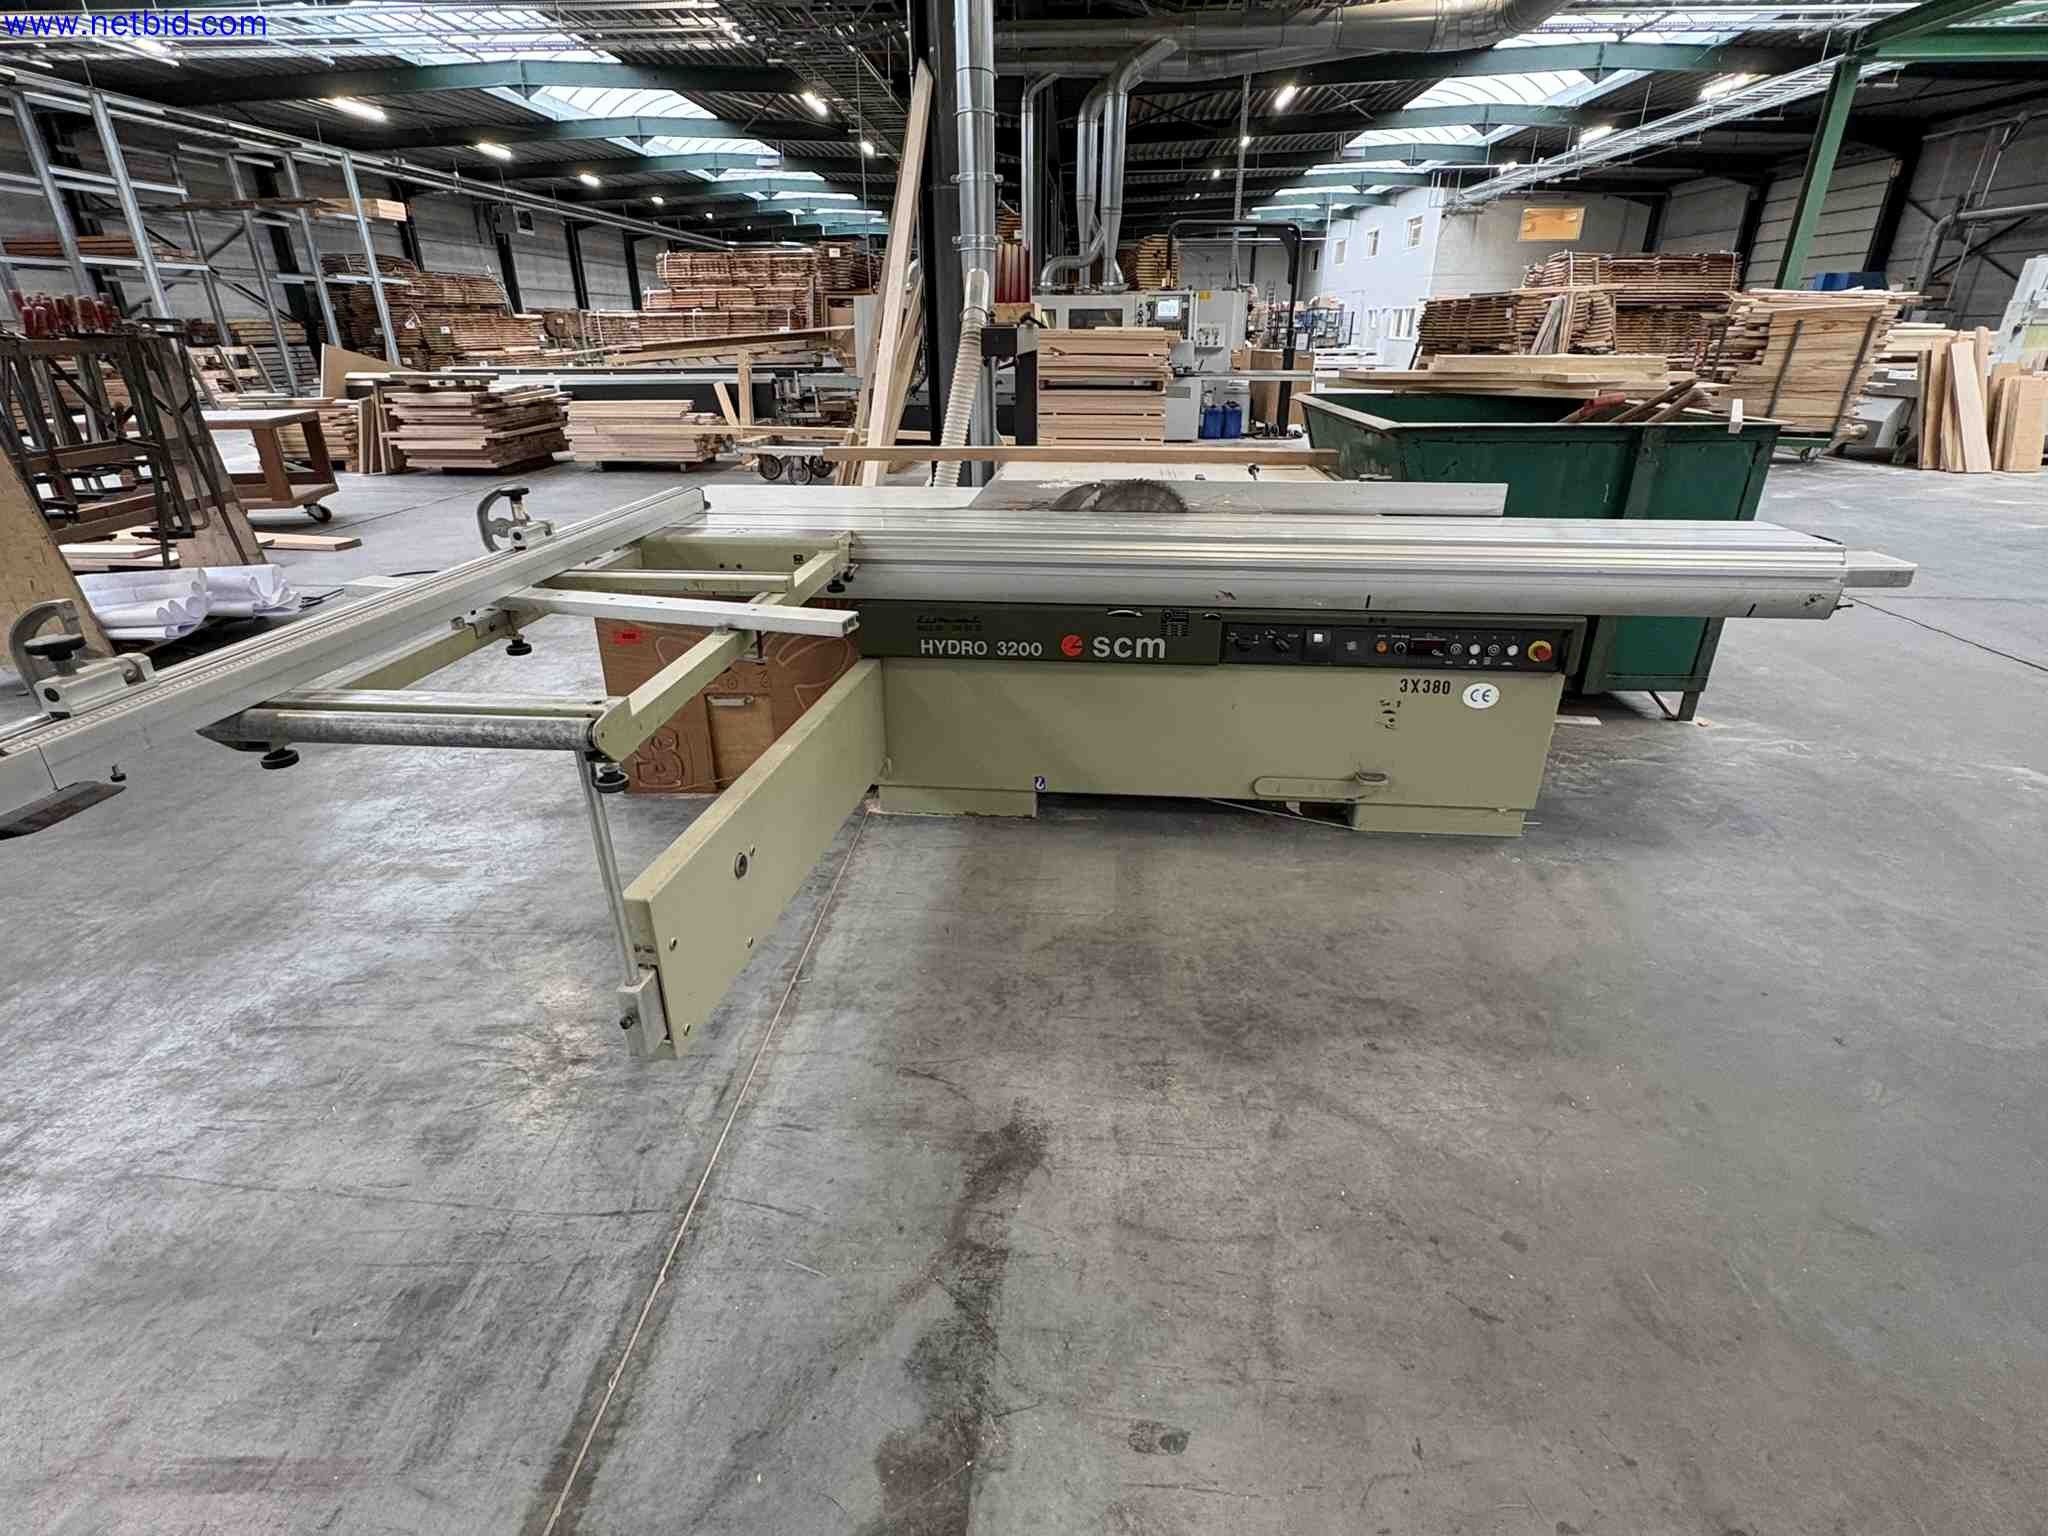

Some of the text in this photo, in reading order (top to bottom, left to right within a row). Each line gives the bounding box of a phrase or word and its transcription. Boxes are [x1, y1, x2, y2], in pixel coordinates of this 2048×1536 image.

[920, 639, 1043, 657] HYDRO 3200
[1092, 636, 1166, 659] scm
[1399, 678, 1452, 695] 3X380
[1469, 688, 1492, 703] CE
